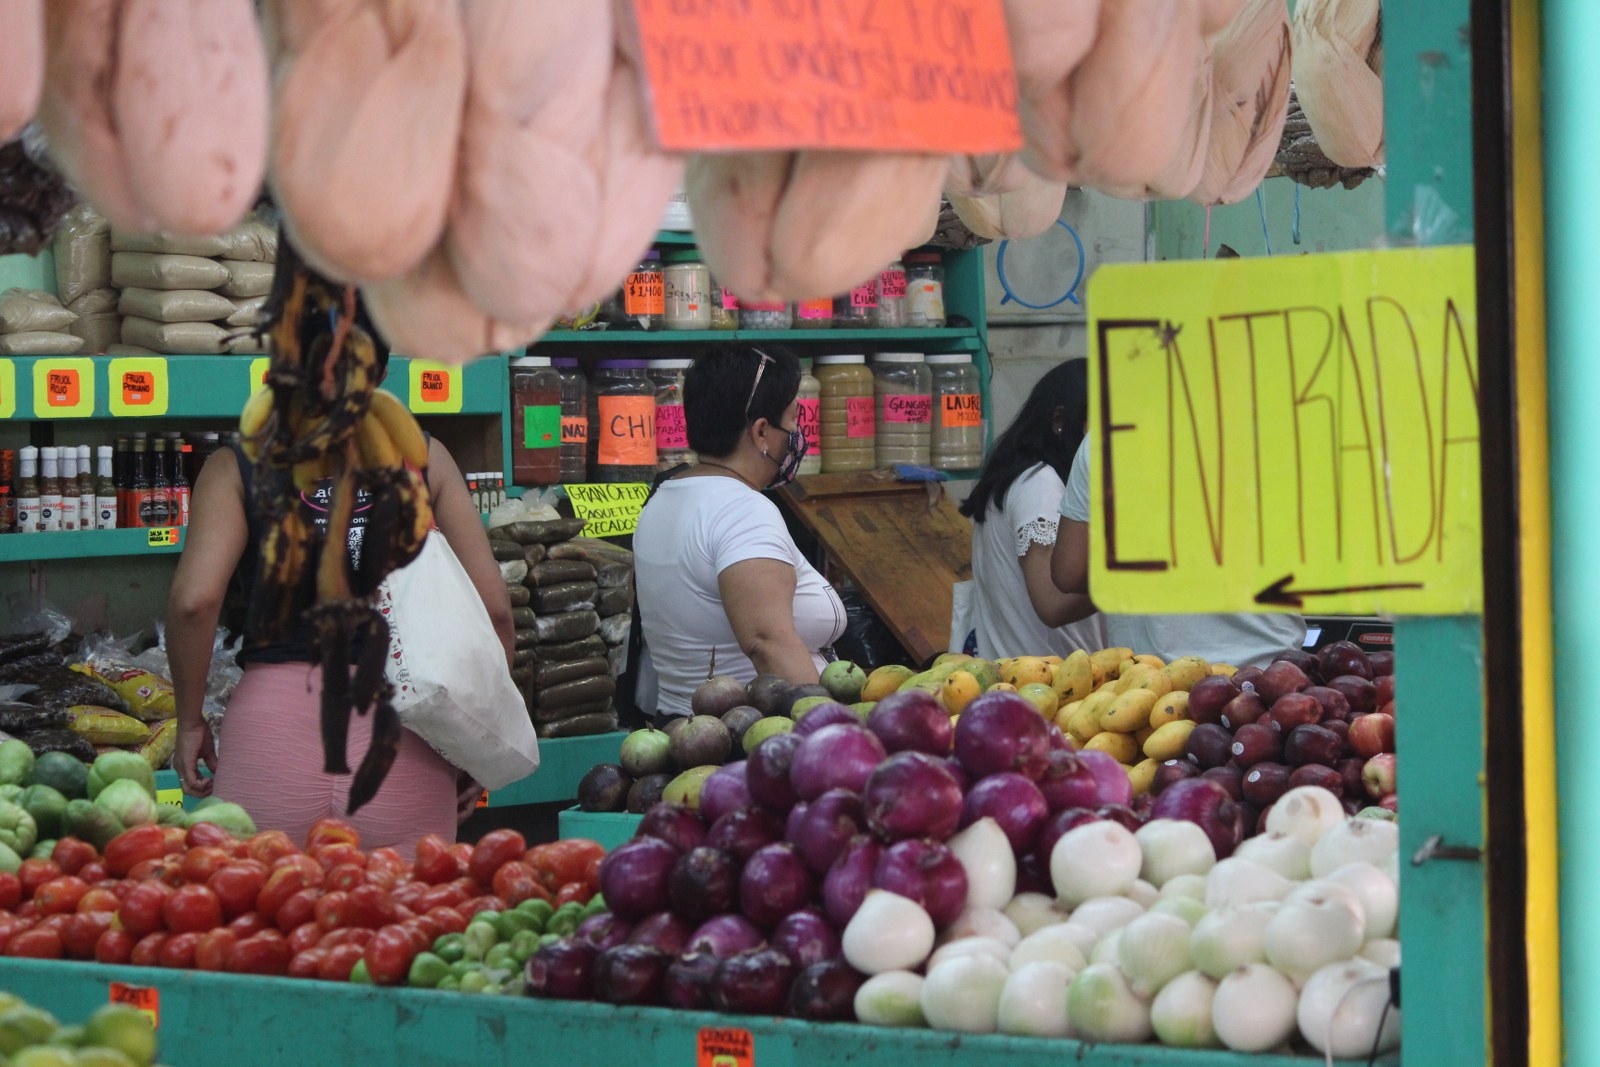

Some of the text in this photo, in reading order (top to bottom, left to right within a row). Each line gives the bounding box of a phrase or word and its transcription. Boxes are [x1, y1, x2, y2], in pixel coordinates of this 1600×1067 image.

[50, 383, 68, 394] ROJO
[1096, 297, 1480, 571] ENTRADA
[576, 504, 640, 520] PAQUETES
